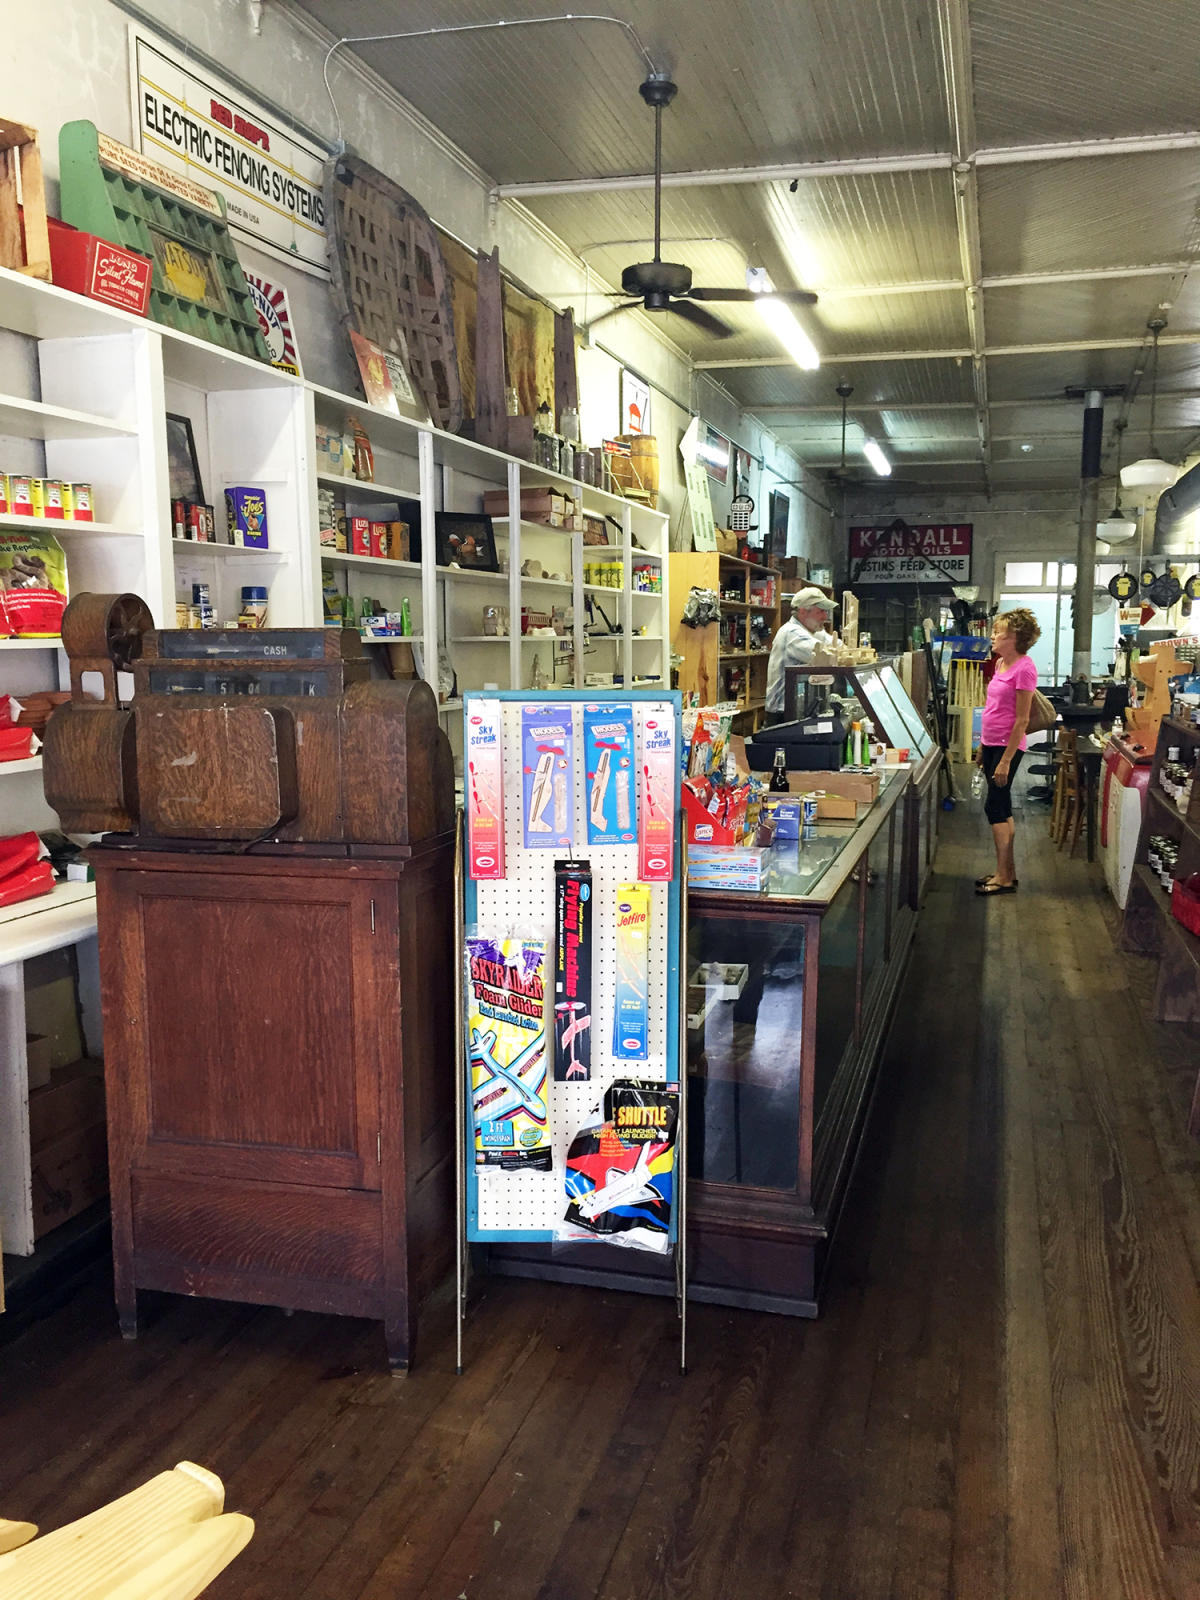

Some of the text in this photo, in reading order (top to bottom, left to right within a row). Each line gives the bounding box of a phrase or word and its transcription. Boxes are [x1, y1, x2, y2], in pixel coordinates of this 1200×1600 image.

[145, 93, 325, 226] ELECTRIC FENCING SYSTEMS
[227, 201, 260, 224] MADE IN USA
[109, 252, 138, 273] LONG
[97, 259, 145, 289] Silent Flame
[922, 546, 951, 555] OILS
[900, 559, 926, 571] FEED
[930, 559, 965, 570] STORE
[264, 646, 287, 655] CASH
[479, 726, 493, 735] Sky
[654, 730, 668, 739] Sky
[471, 734, 496, 745] Streak
[646, 738, 671, 749] Streak
[617, 912, 646, 927] Jetfire
[564, 880, 580, 998] Flying Machine
[470, 955, 544, 1001] SKYRAIDER
[474, 982, 543, 1018] Foam Glider
[618, 1106, 667, 1126] SHUTTLE
[496, 1122, 504, 1132] FT
